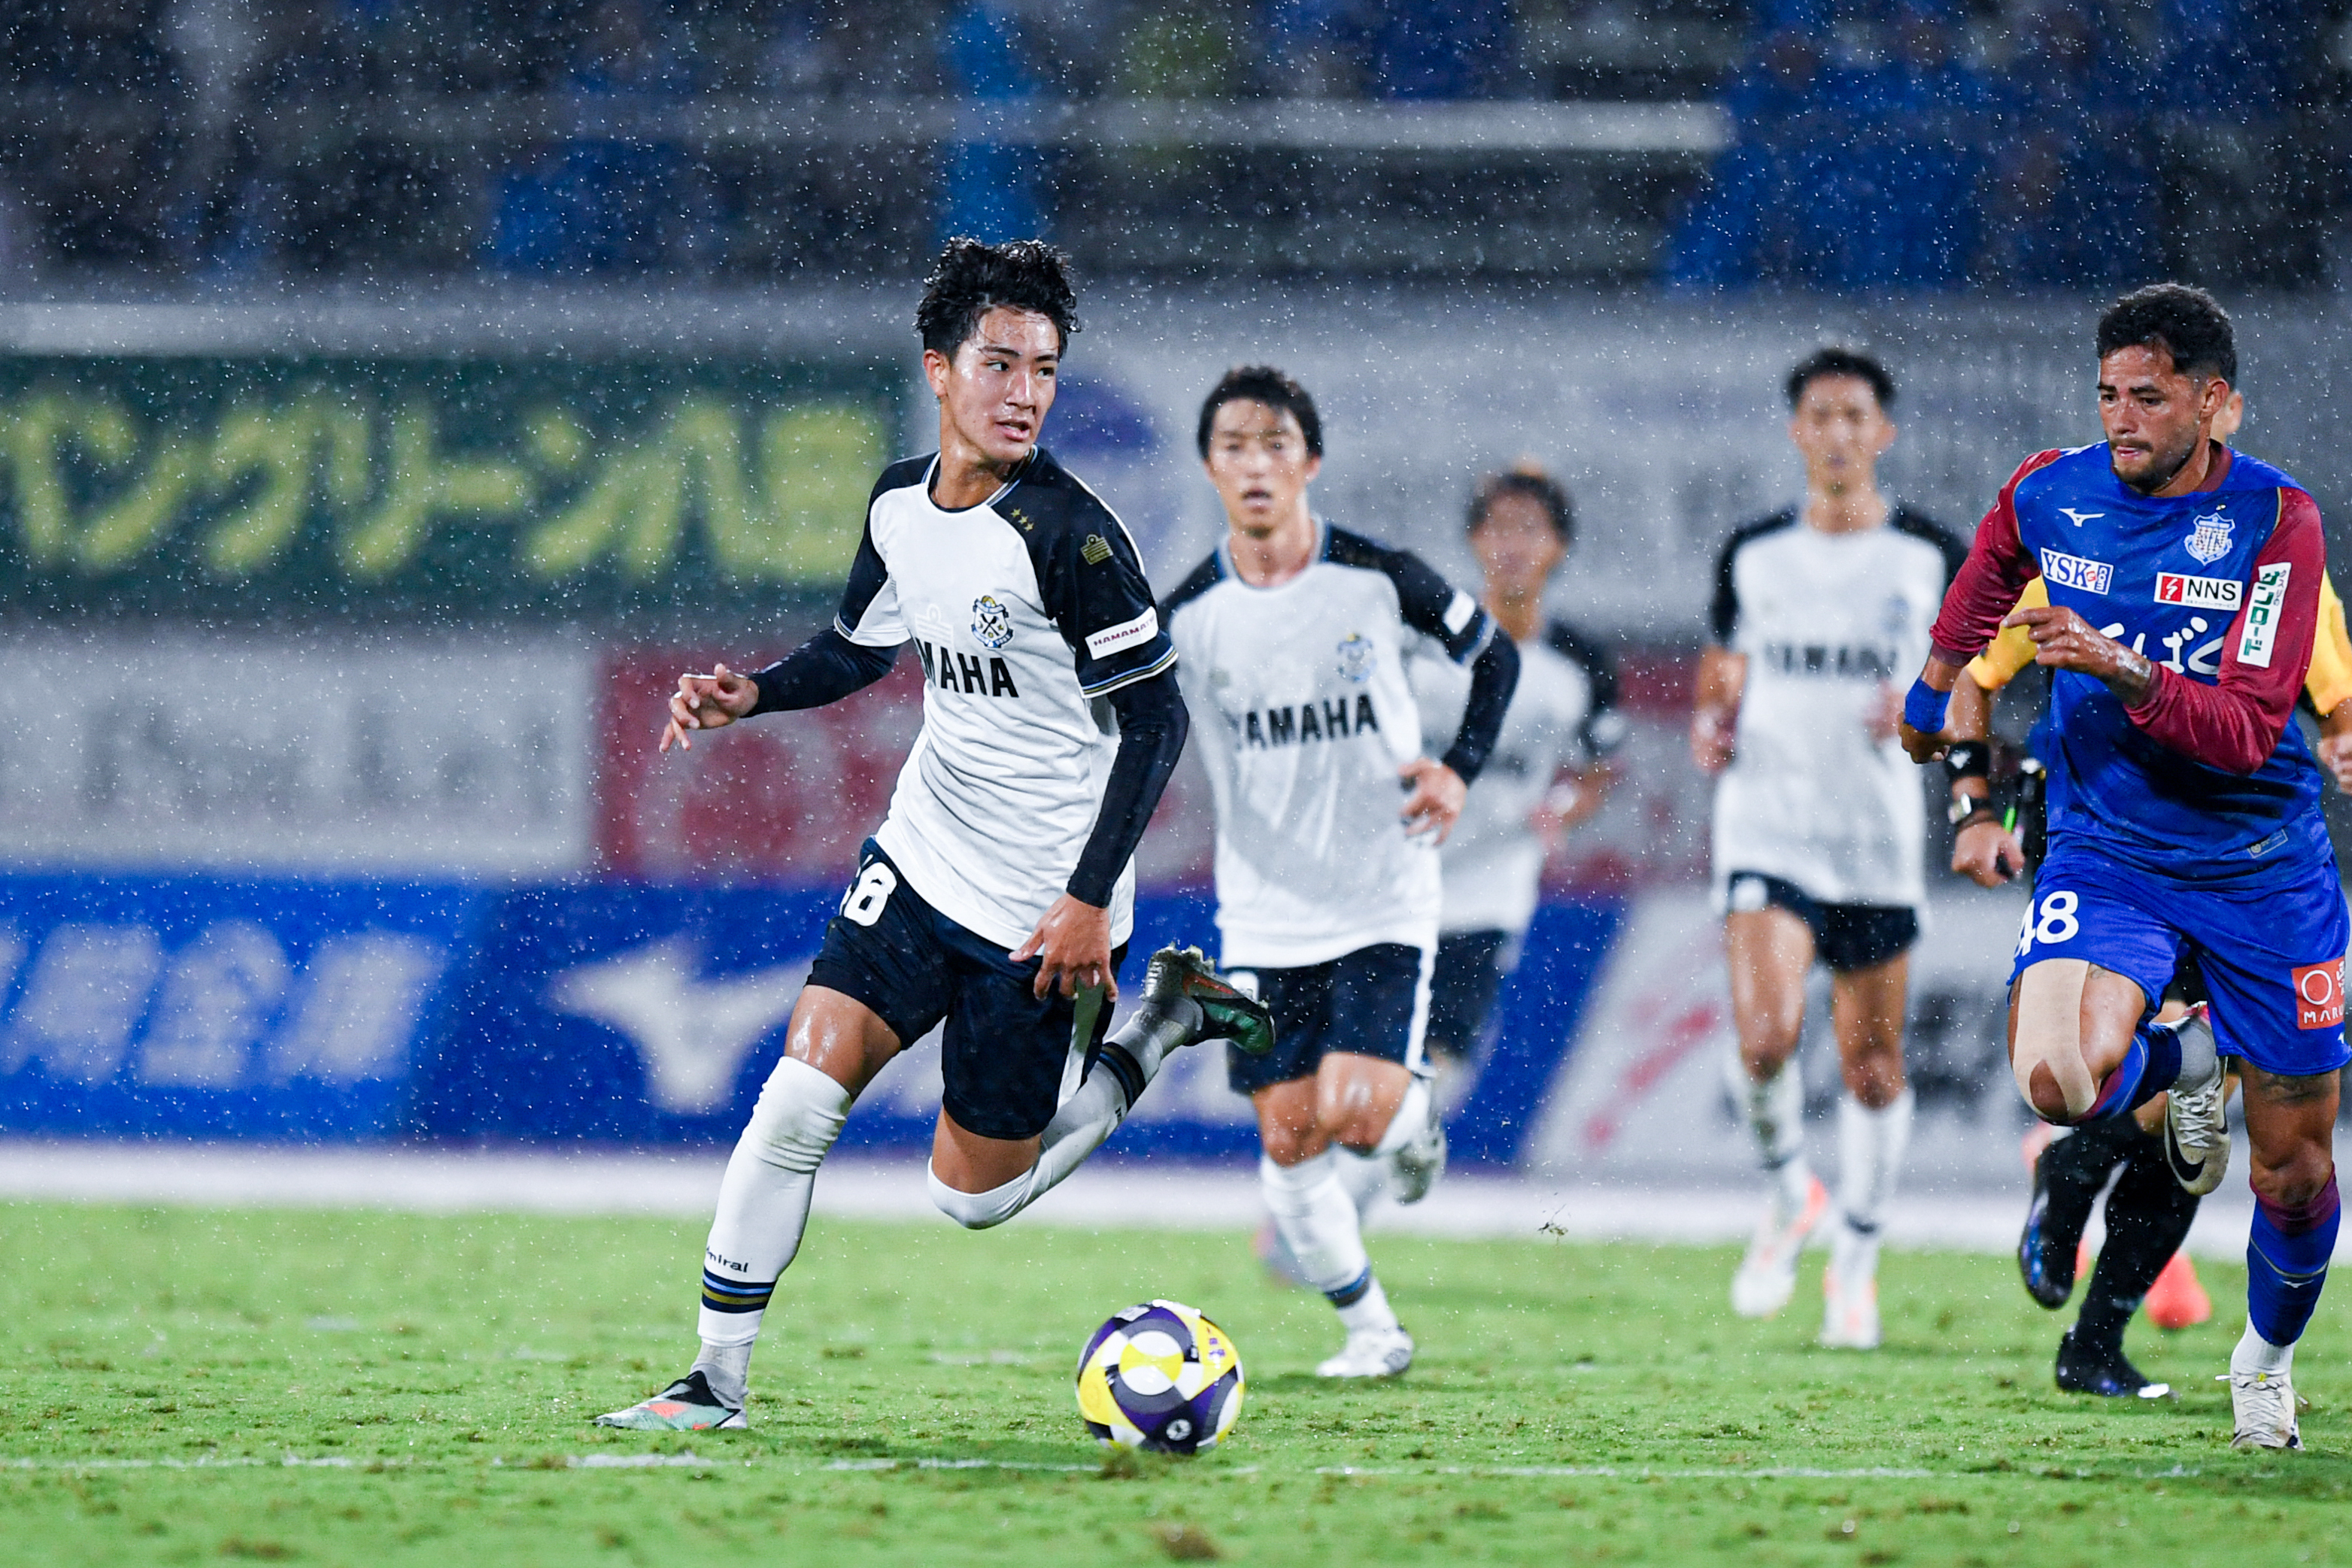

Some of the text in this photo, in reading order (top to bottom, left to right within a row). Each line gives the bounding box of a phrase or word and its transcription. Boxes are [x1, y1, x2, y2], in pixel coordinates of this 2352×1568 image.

[2043, 551, 2092, 588] YSK
[2187, 578, 2237, 602] NNS
[914, 637, 1019, 698] MAHA
[2014, 890, 2080, 958] 48
[2303, 1004, 2345, 1024] MARU
[706, 1245, 749, 1273] miral
